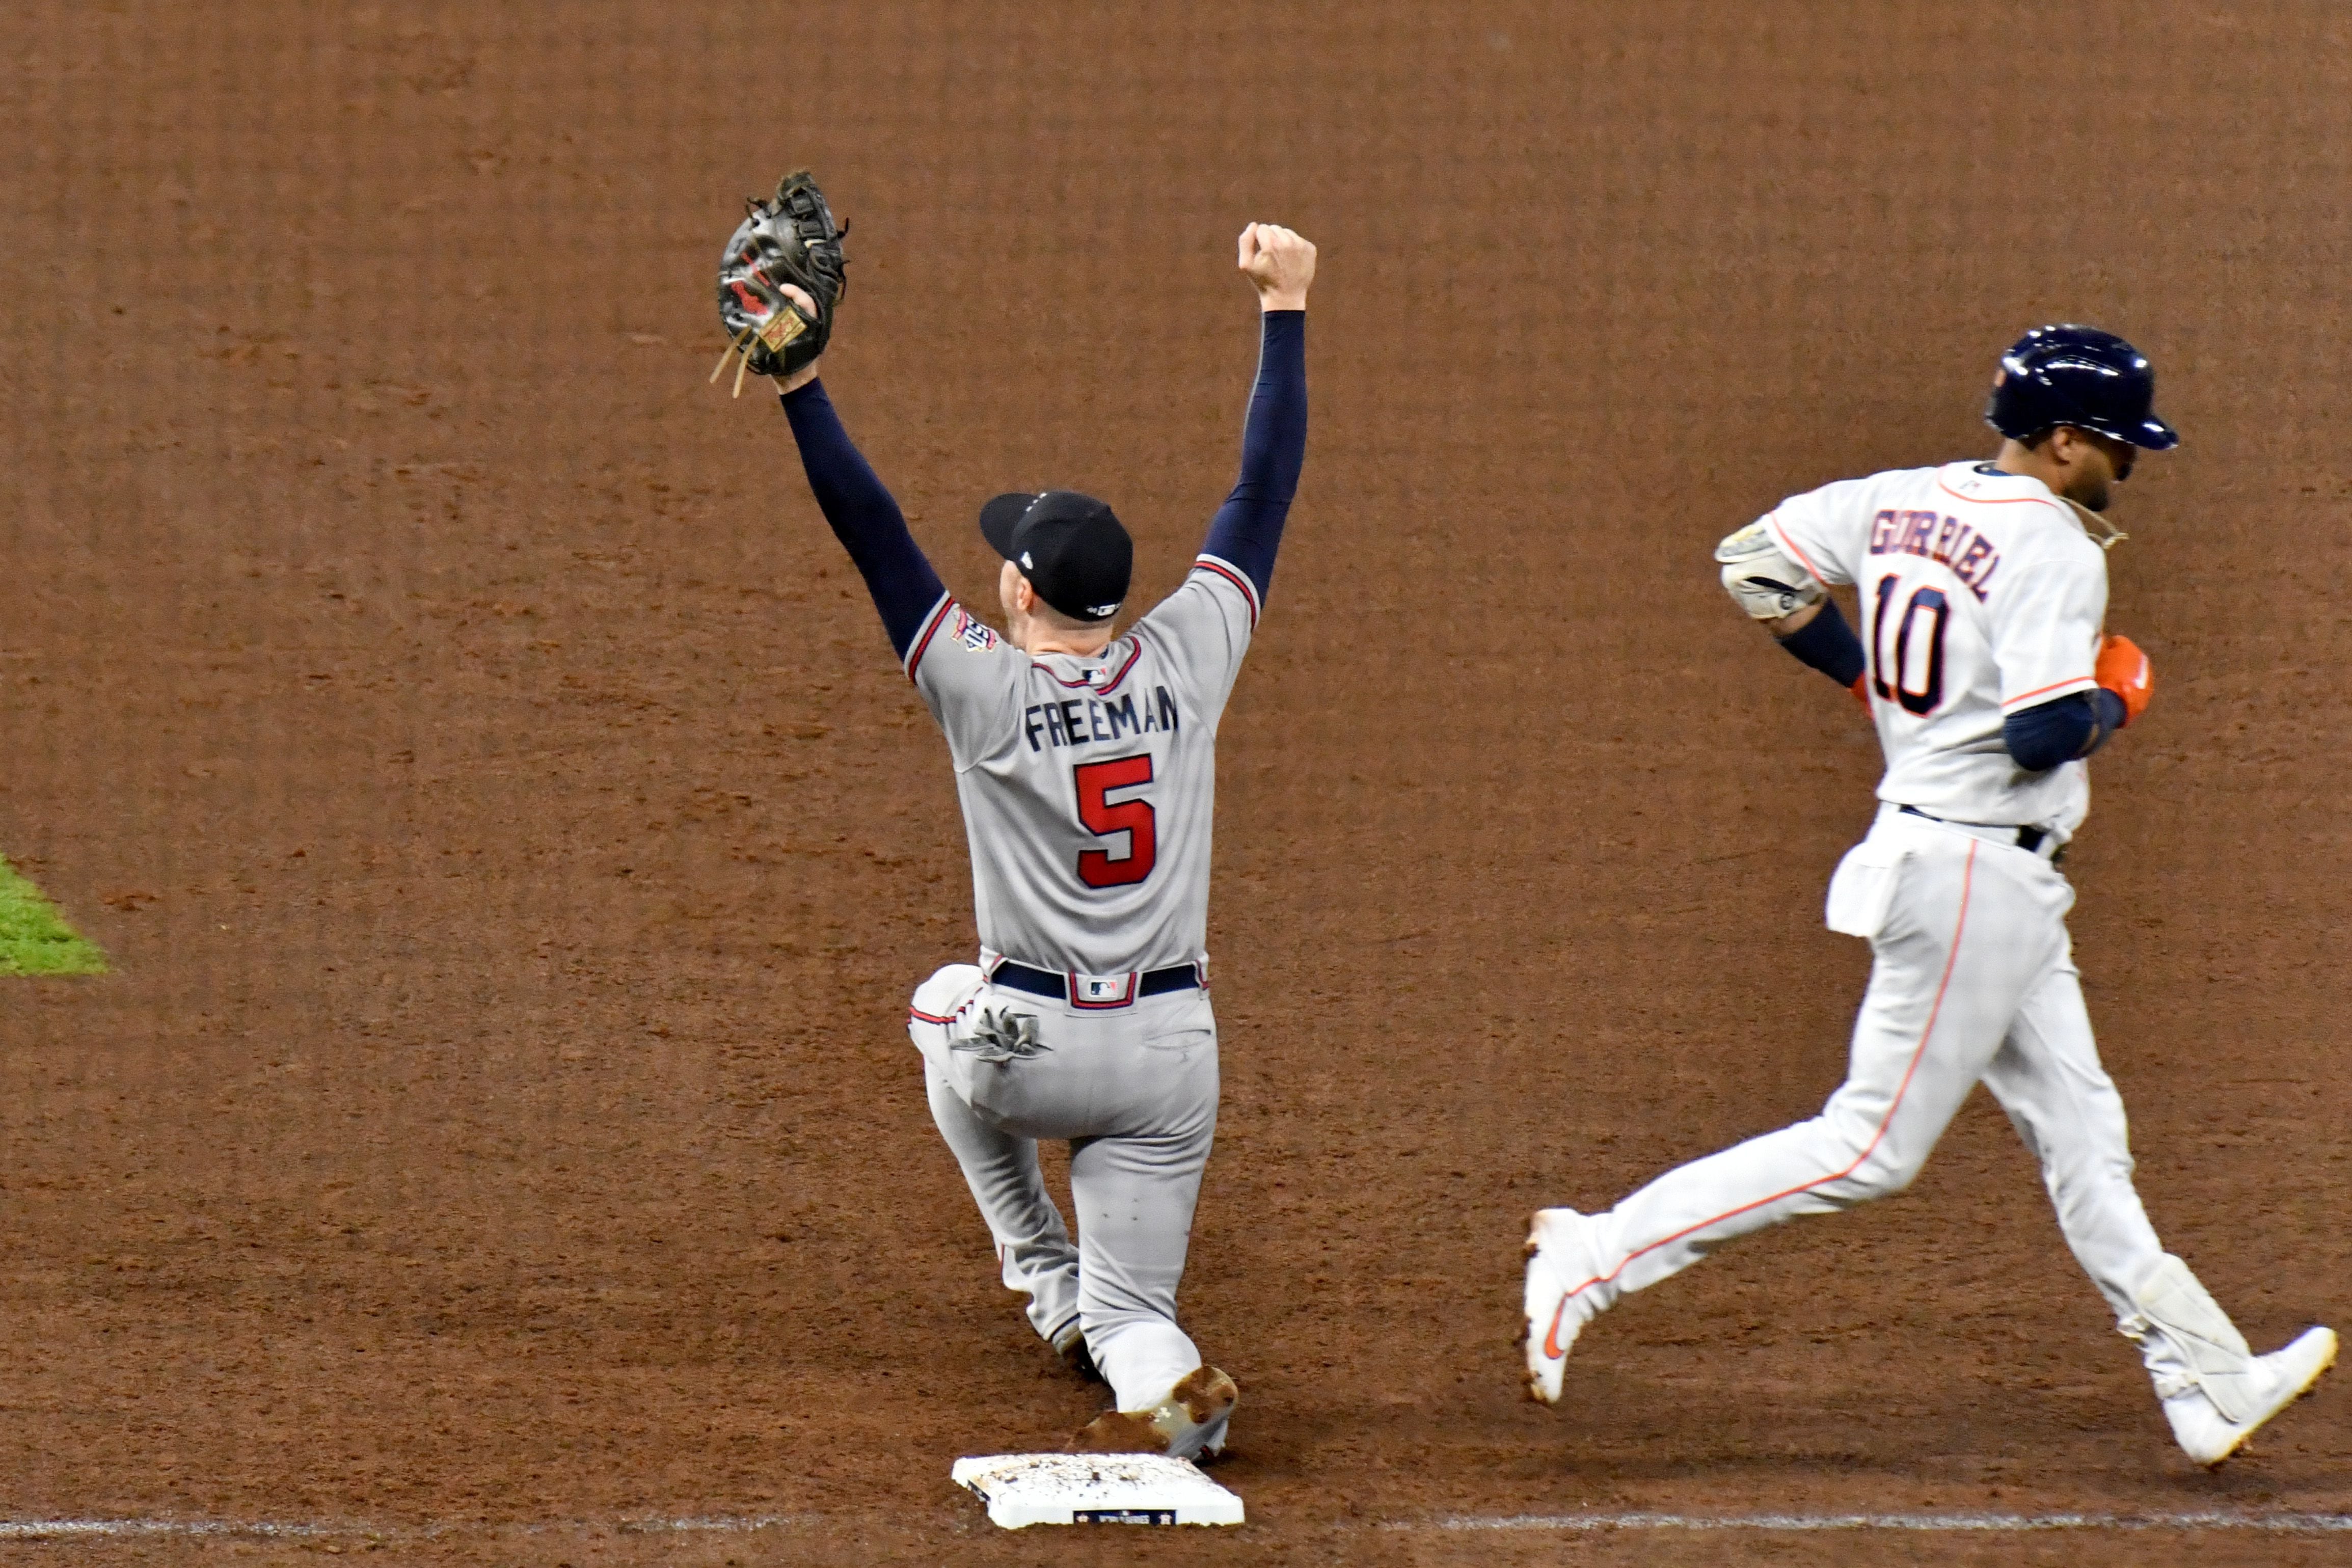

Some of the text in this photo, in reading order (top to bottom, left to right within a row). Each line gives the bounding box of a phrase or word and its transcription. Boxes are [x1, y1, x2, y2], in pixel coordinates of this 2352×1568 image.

[1873, 573, 1951, 718] 10
[1025, 686, 1178, 752] FREEMAN
[1073, 753, 1156, 889] 5
